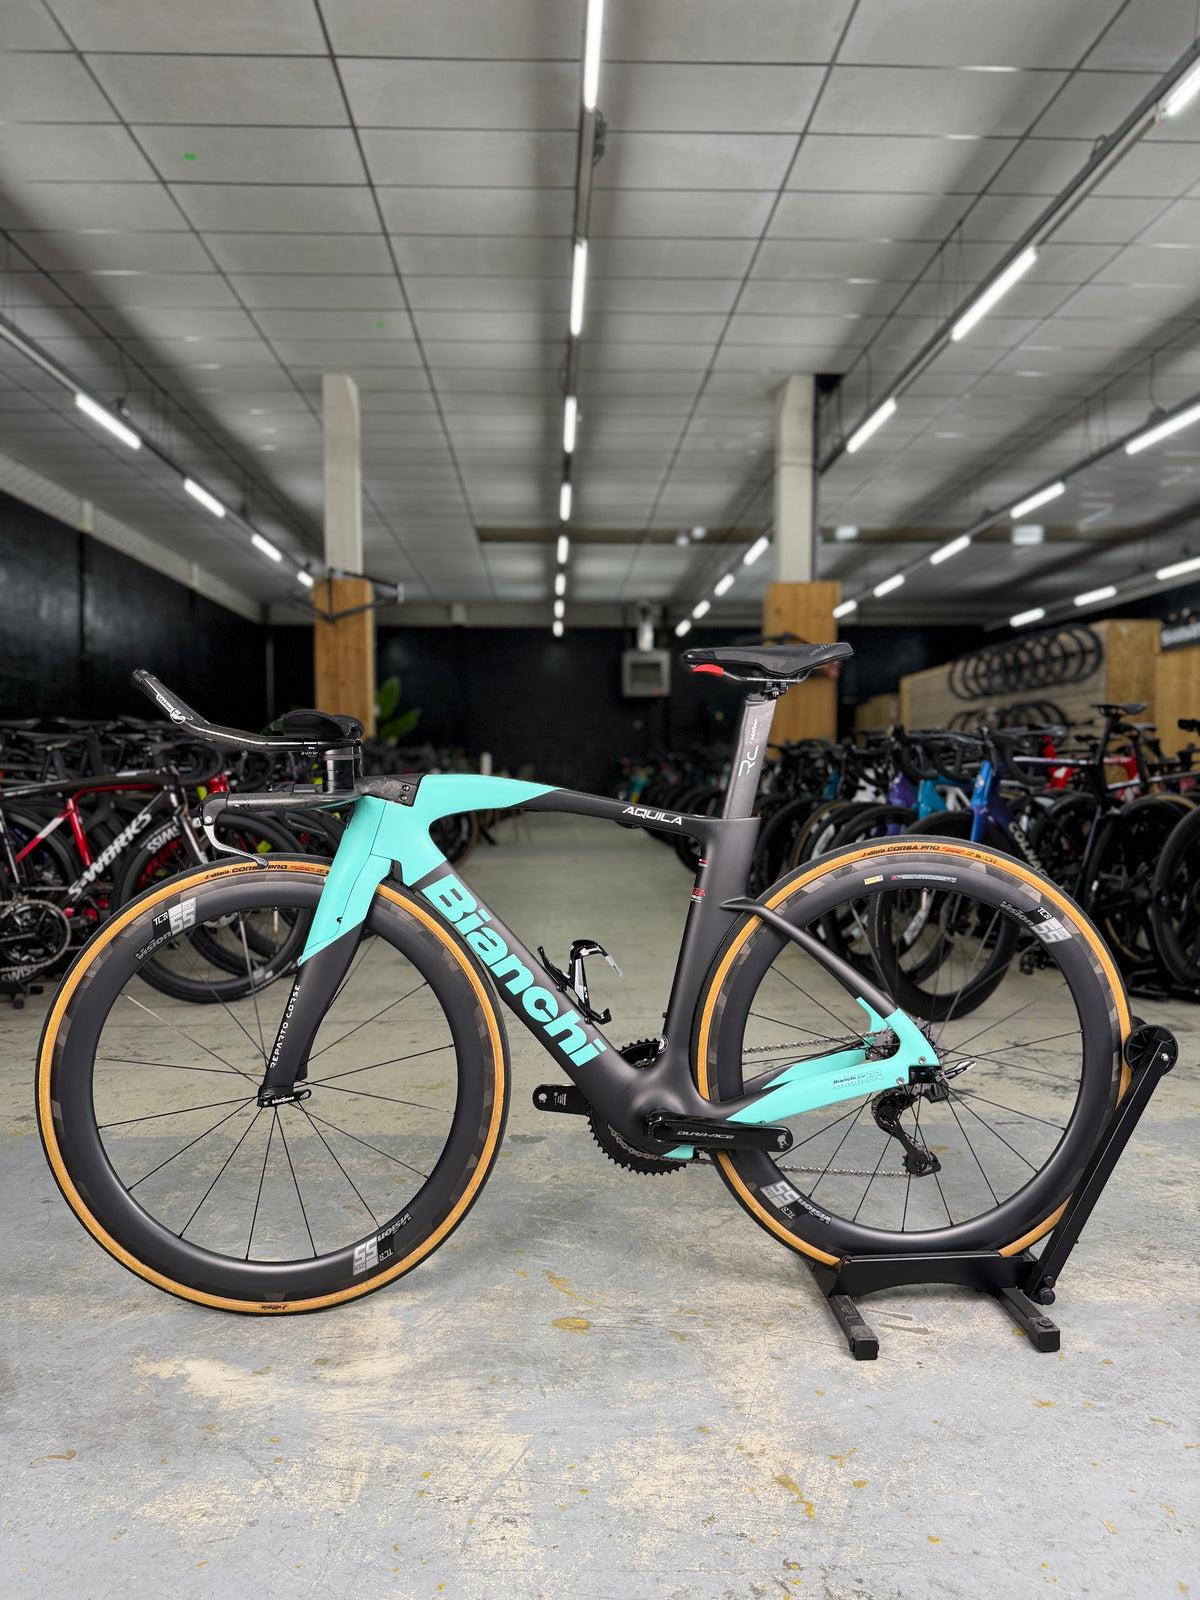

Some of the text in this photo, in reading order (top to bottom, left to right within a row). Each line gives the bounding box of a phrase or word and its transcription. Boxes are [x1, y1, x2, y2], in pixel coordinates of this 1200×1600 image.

[622, 806, 682, 826] AQUILA
[68, 812, 152, 902] S-WORKS
[231, 865, 259, 874] CORS
[169, 906, 197, 936] 55
[1030, 919, 1067, 944] 55
[421, 873, 607, 1067] Bianchi
[270, 984, 301, 1068] REPARTO CORSE
[677, 1130, 735, 1139] DURA-ACE
